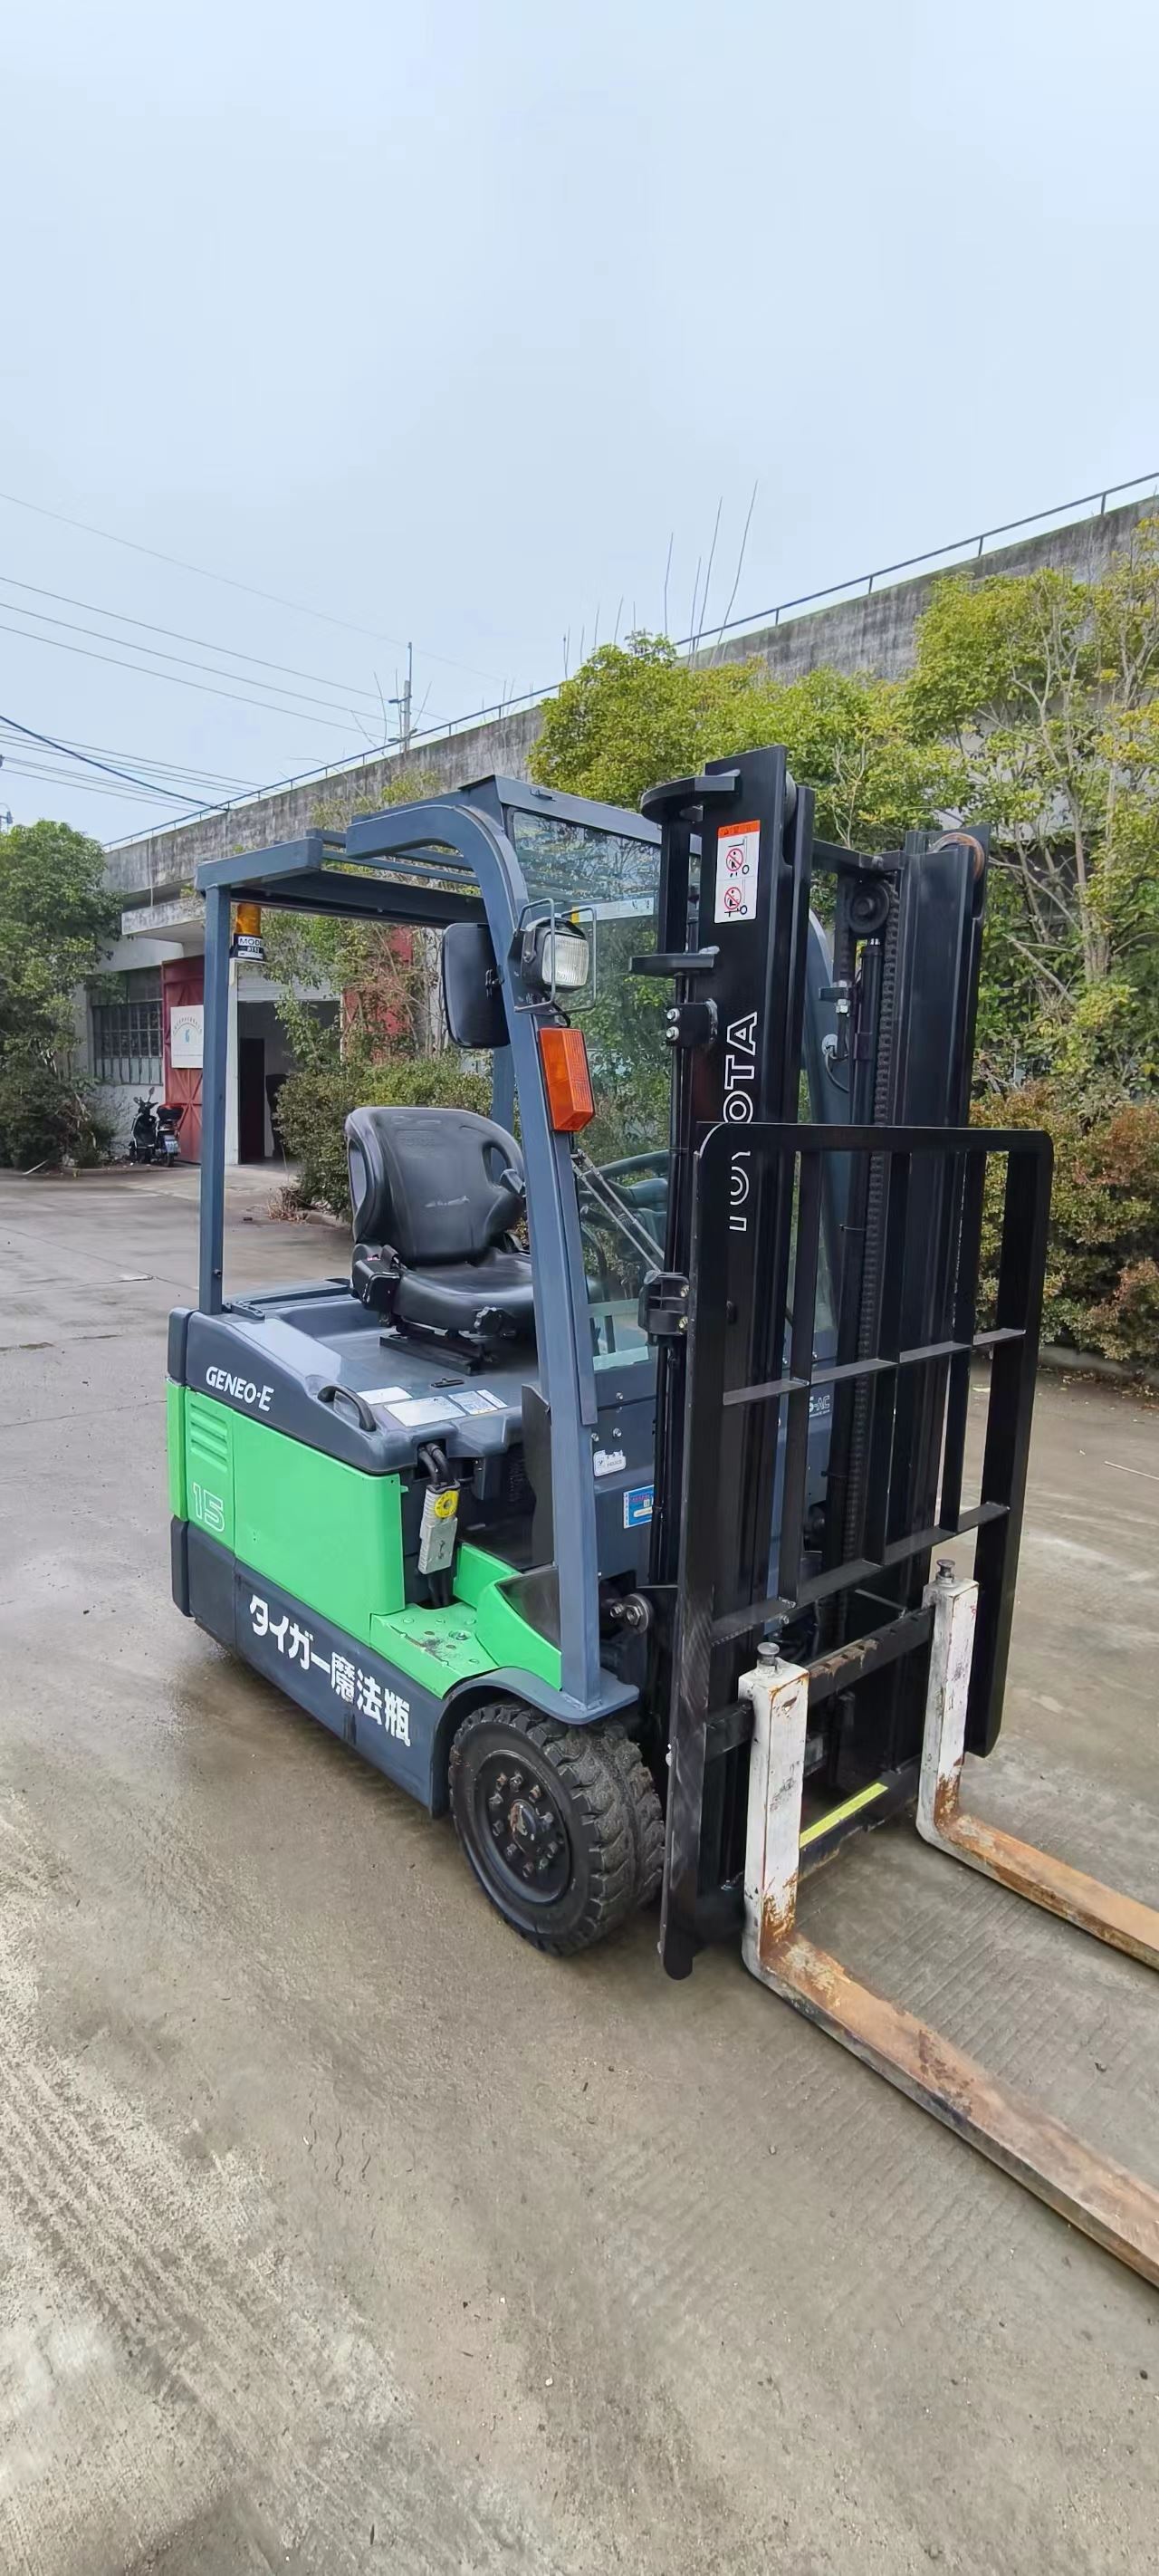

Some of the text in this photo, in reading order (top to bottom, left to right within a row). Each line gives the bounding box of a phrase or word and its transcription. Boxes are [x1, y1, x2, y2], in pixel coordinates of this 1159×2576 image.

[193, 1482, 225, 1533] 15
[249, 1594, 411, 1747] タイガー魔法瓶
